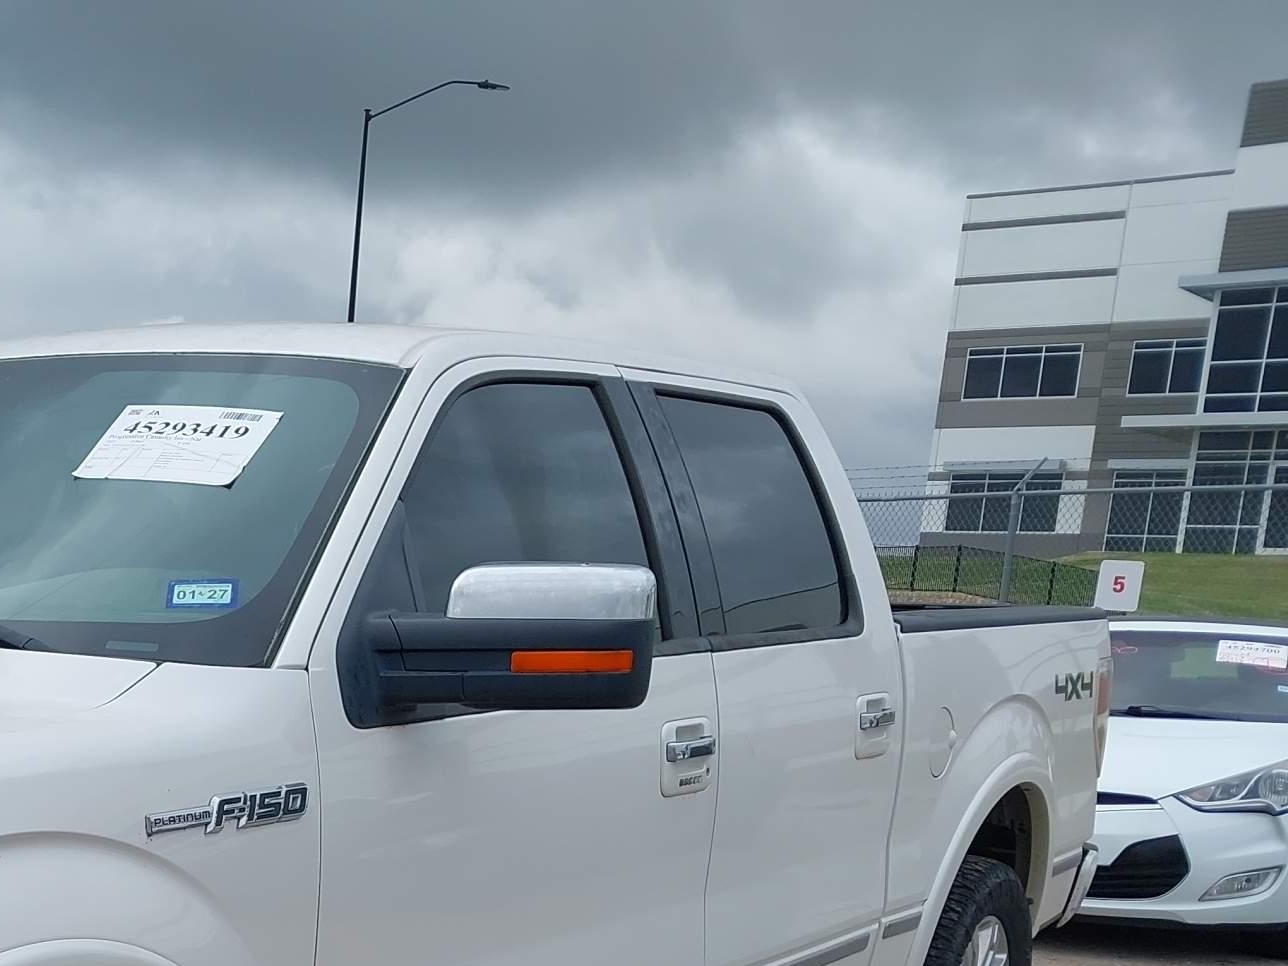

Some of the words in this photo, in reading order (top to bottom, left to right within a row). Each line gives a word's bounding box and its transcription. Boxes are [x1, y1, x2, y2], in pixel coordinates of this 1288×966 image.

[123, 420, 251, 440] 45293419
[1112, 575, 1127, 594] 5
[176, 590, 196, 601] 01
[207, 588, 229, 600] 27
[153, 810, 211, 828] PLATINUM
[209, 784, 309, 832] F-150
